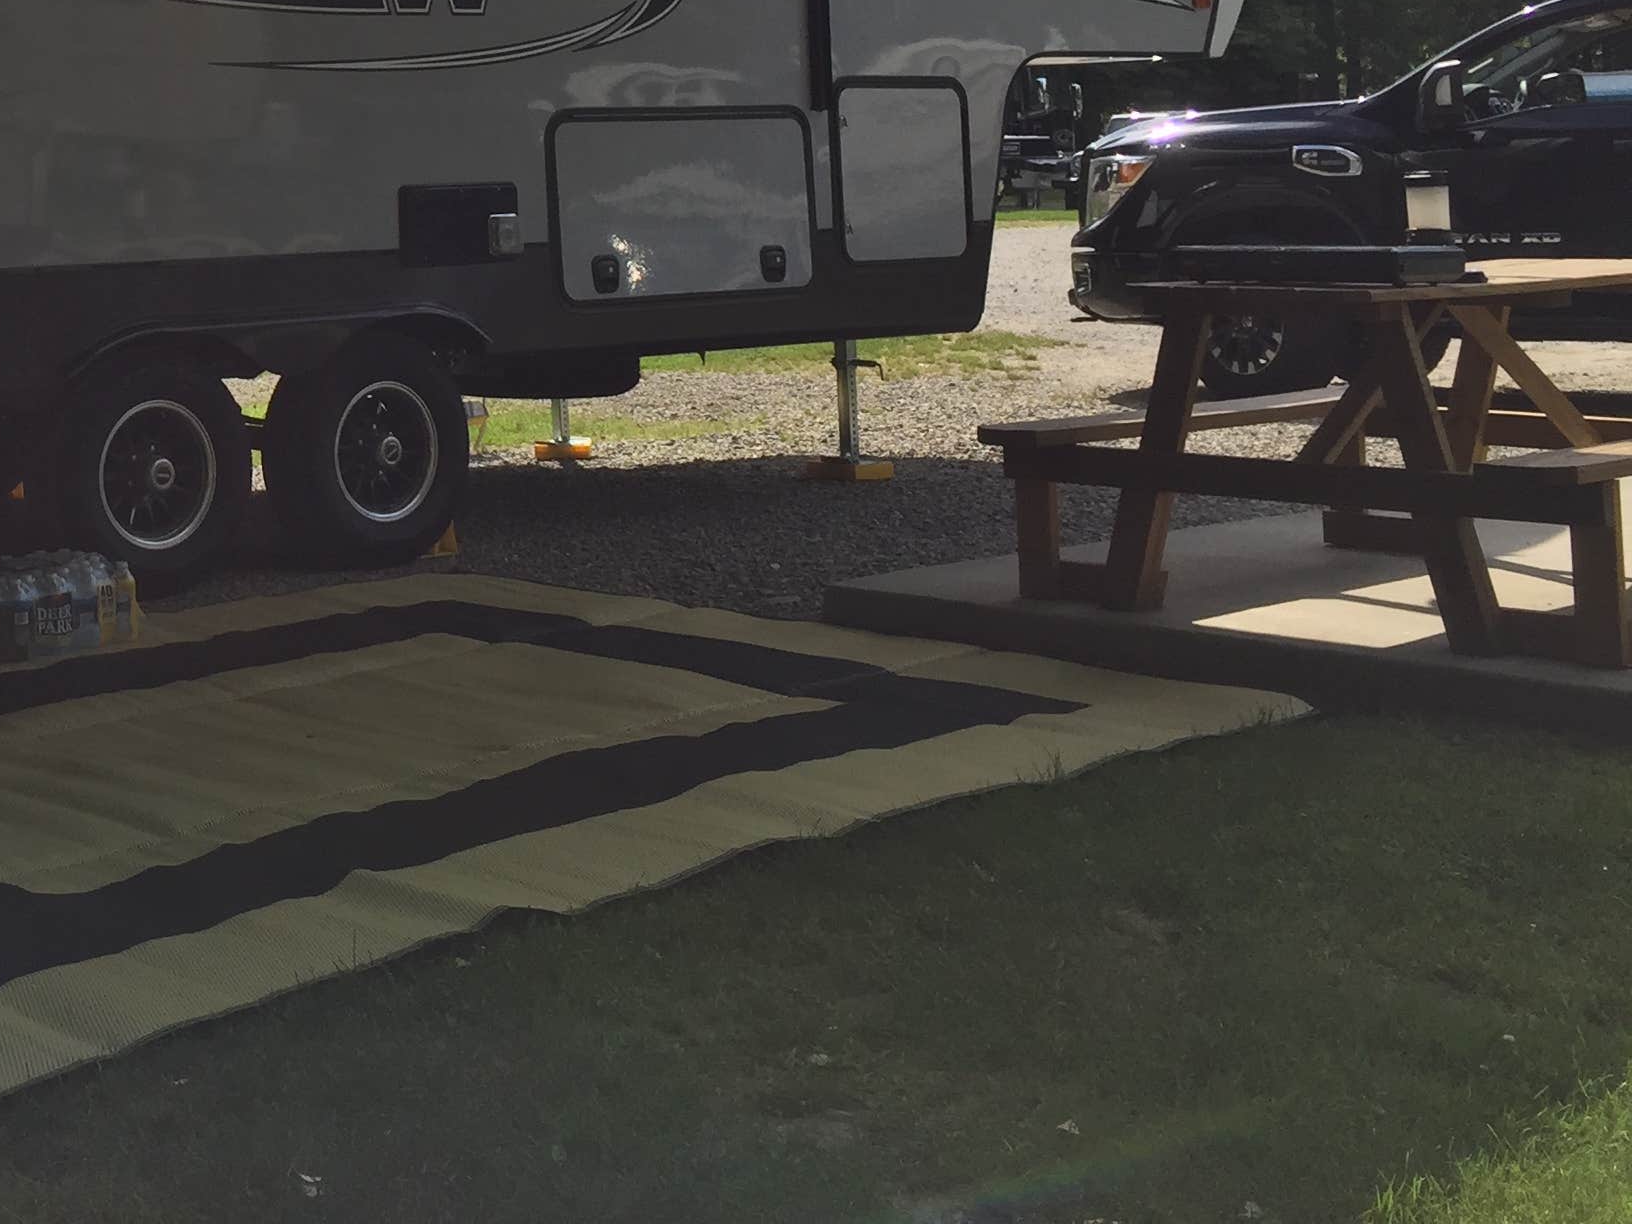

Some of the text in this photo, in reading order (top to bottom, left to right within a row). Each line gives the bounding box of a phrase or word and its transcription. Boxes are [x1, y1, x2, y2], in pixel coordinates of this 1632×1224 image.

[1452, 231, 1561, 244] TAN XD
[36, 603, 72, 621] DEER
[37, 617, 73, 633] PARK
